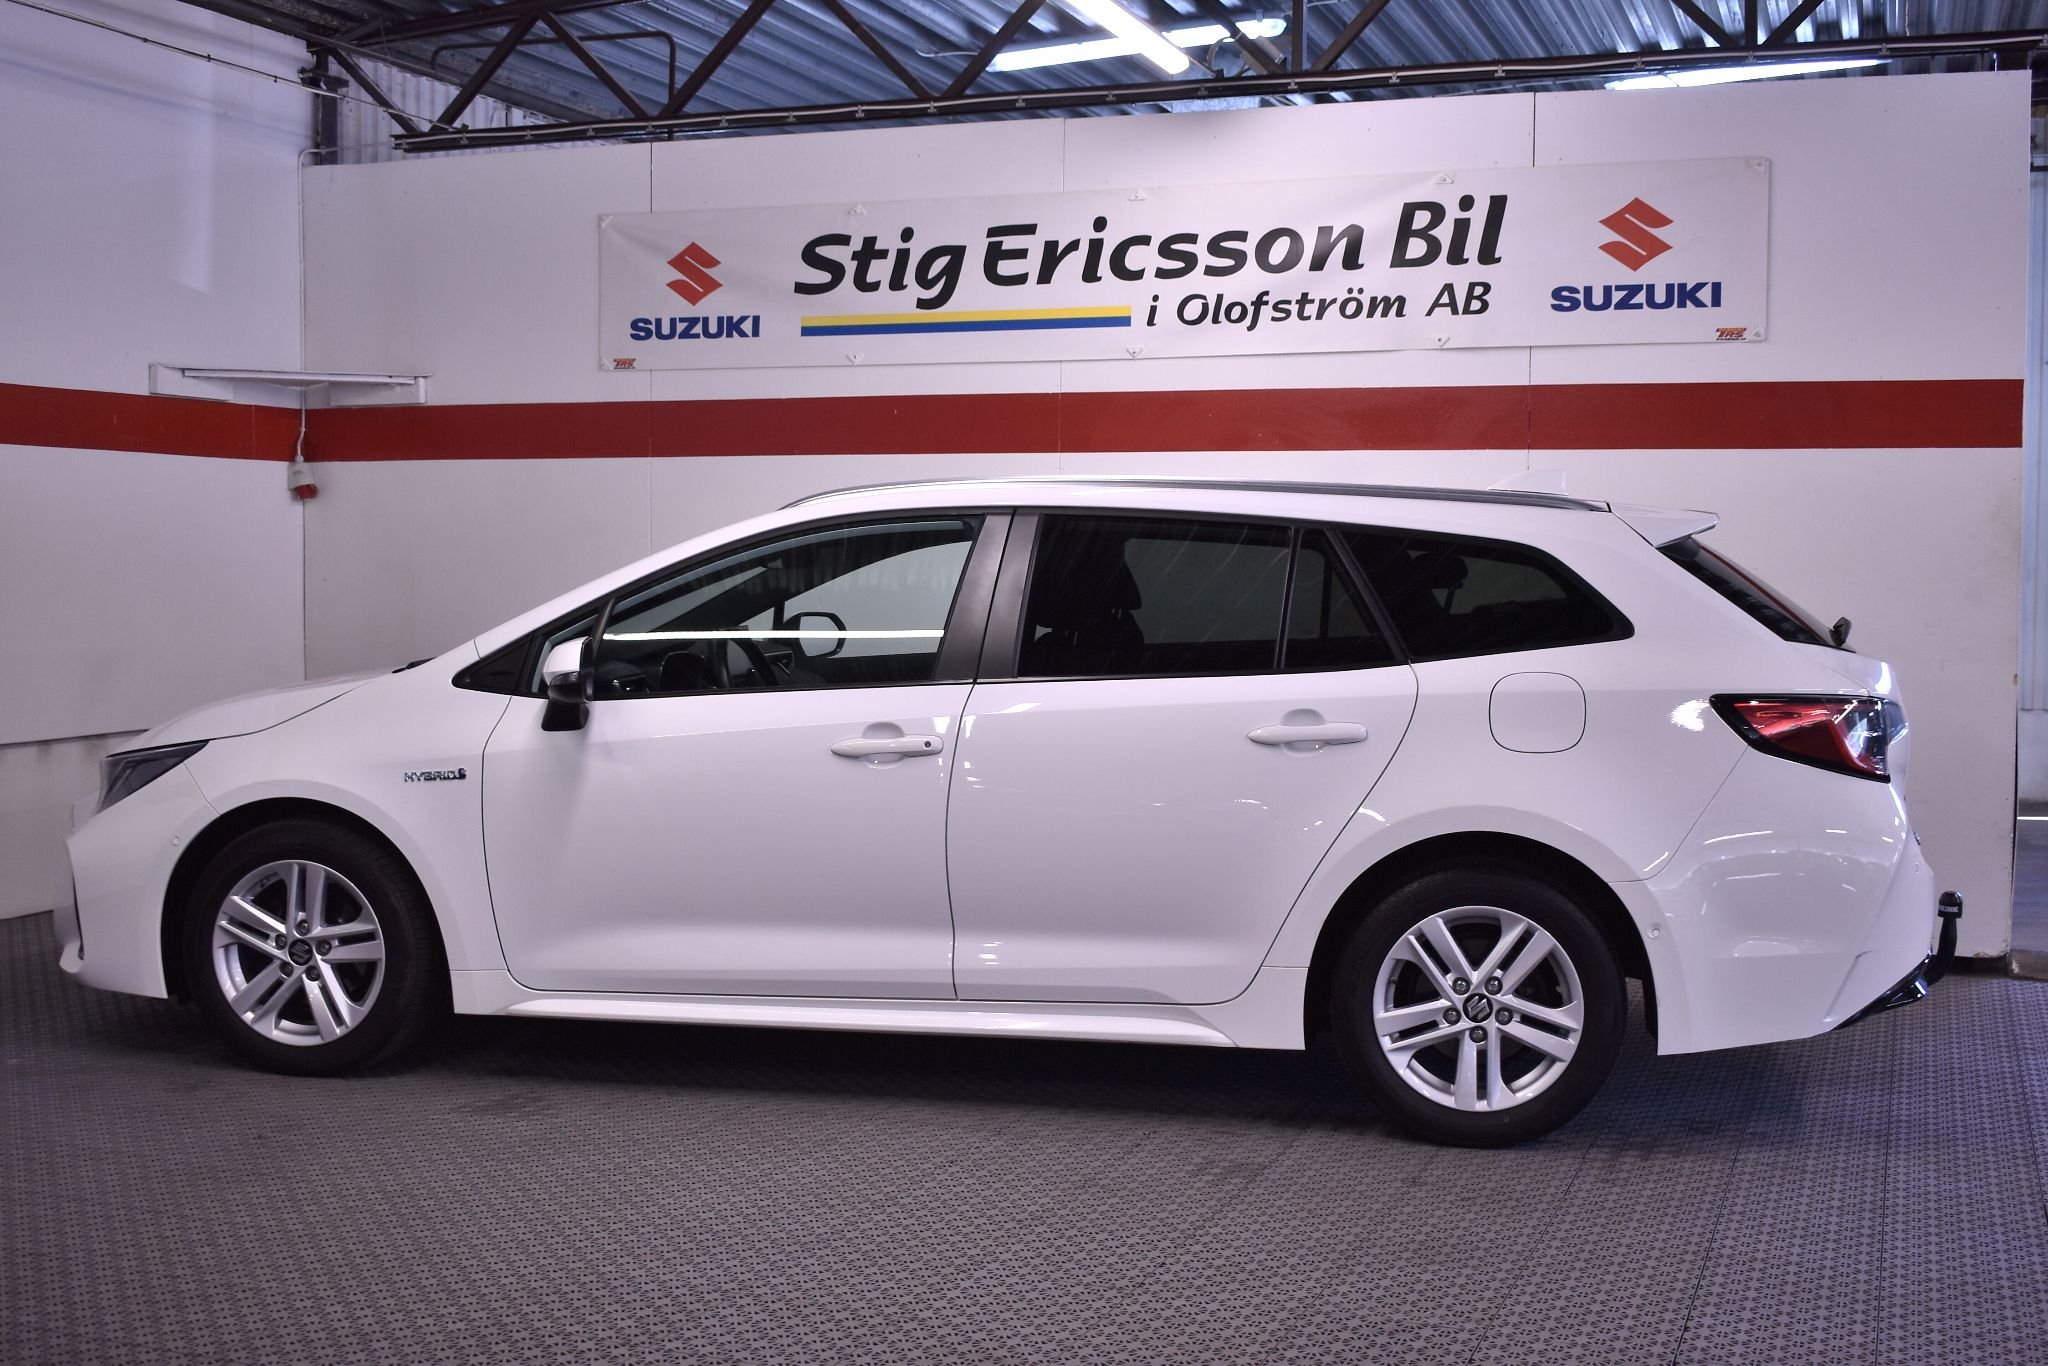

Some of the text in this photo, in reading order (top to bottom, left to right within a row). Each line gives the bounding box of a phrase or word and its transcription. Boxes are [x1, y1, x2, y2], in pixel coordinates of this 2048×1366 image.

[793, 194, 1509, 310] Stig Ericsson Bil
[1146, 281, 1493, 333] i Olofström AB
[1550, 281, 1723, 313] SUZUKI
[629, 314, 762, 342] SUZUKI
